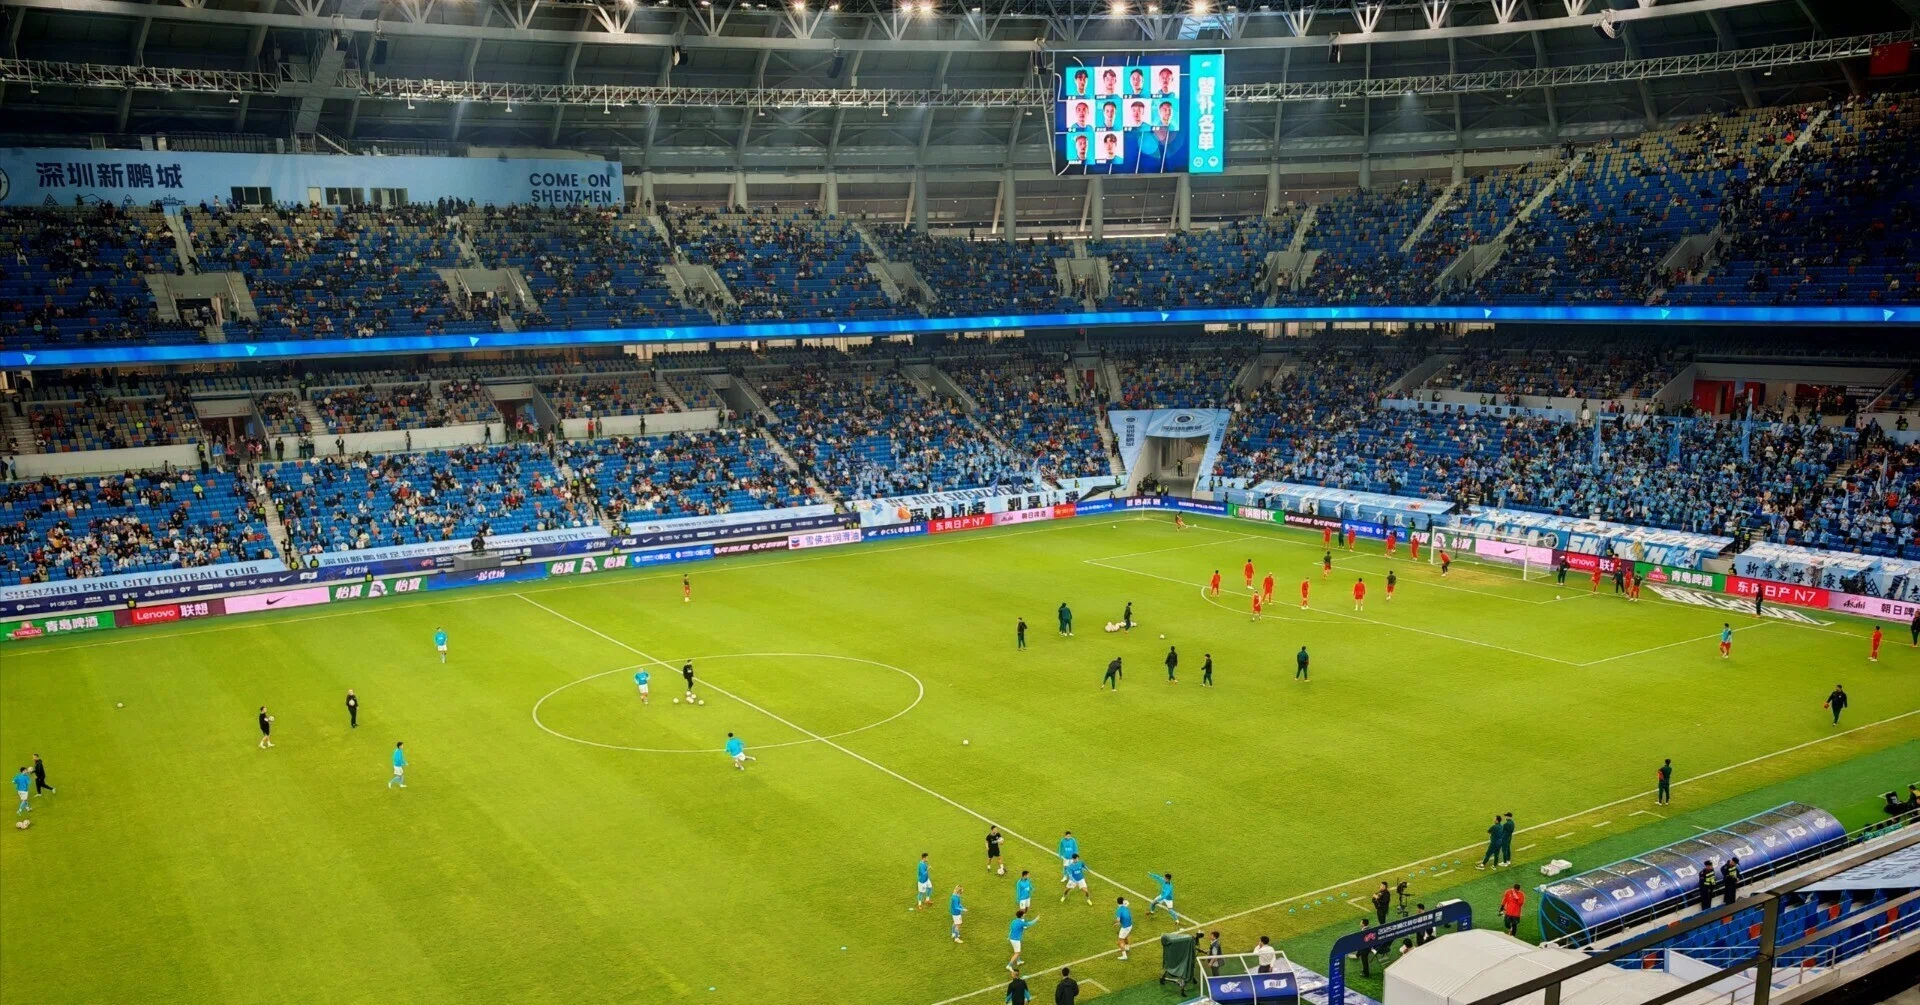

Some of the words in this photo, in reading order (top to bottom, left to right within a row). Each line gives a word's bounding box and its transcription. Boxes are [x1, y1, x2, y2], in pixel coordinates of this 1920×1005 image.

[36, 162, 184, 188] 深圳新鹏城
[529, 173, 579, 187] COME
[588, 174, 611, 187] ON
[532, 189, 612, 202] SHENZHEN
[936, 518, 970, 530] 东风日产
[972, 517, 985, 527] N7
[805, 531, 859, 546] 雪佛龙润滑油
[1567, 556, 1596, 567] Lenovo
[5, 584, 78, 600] SHENZHEN
[83, 580, 118, 592] PENG
[123, 577, 152, 588] CITY
[157, 570, 219, 585] FOOTBALL
[225, 566, 259, 577] CLUB
[1671, 570, 1714, 588] 青岛啤酒
[1737, 580, 1791, 599] 东风日产
[1794, 589, 1816, 603] N7
[180, 602, 208, 617] 联想
[1843, 599, 1866, 610] Asahi
[1881, 603, 1919, 618] 朝日啤
[137, 609, 175, 621] Lenovo
[45, 616, 98, 633] 青岛啤酒
